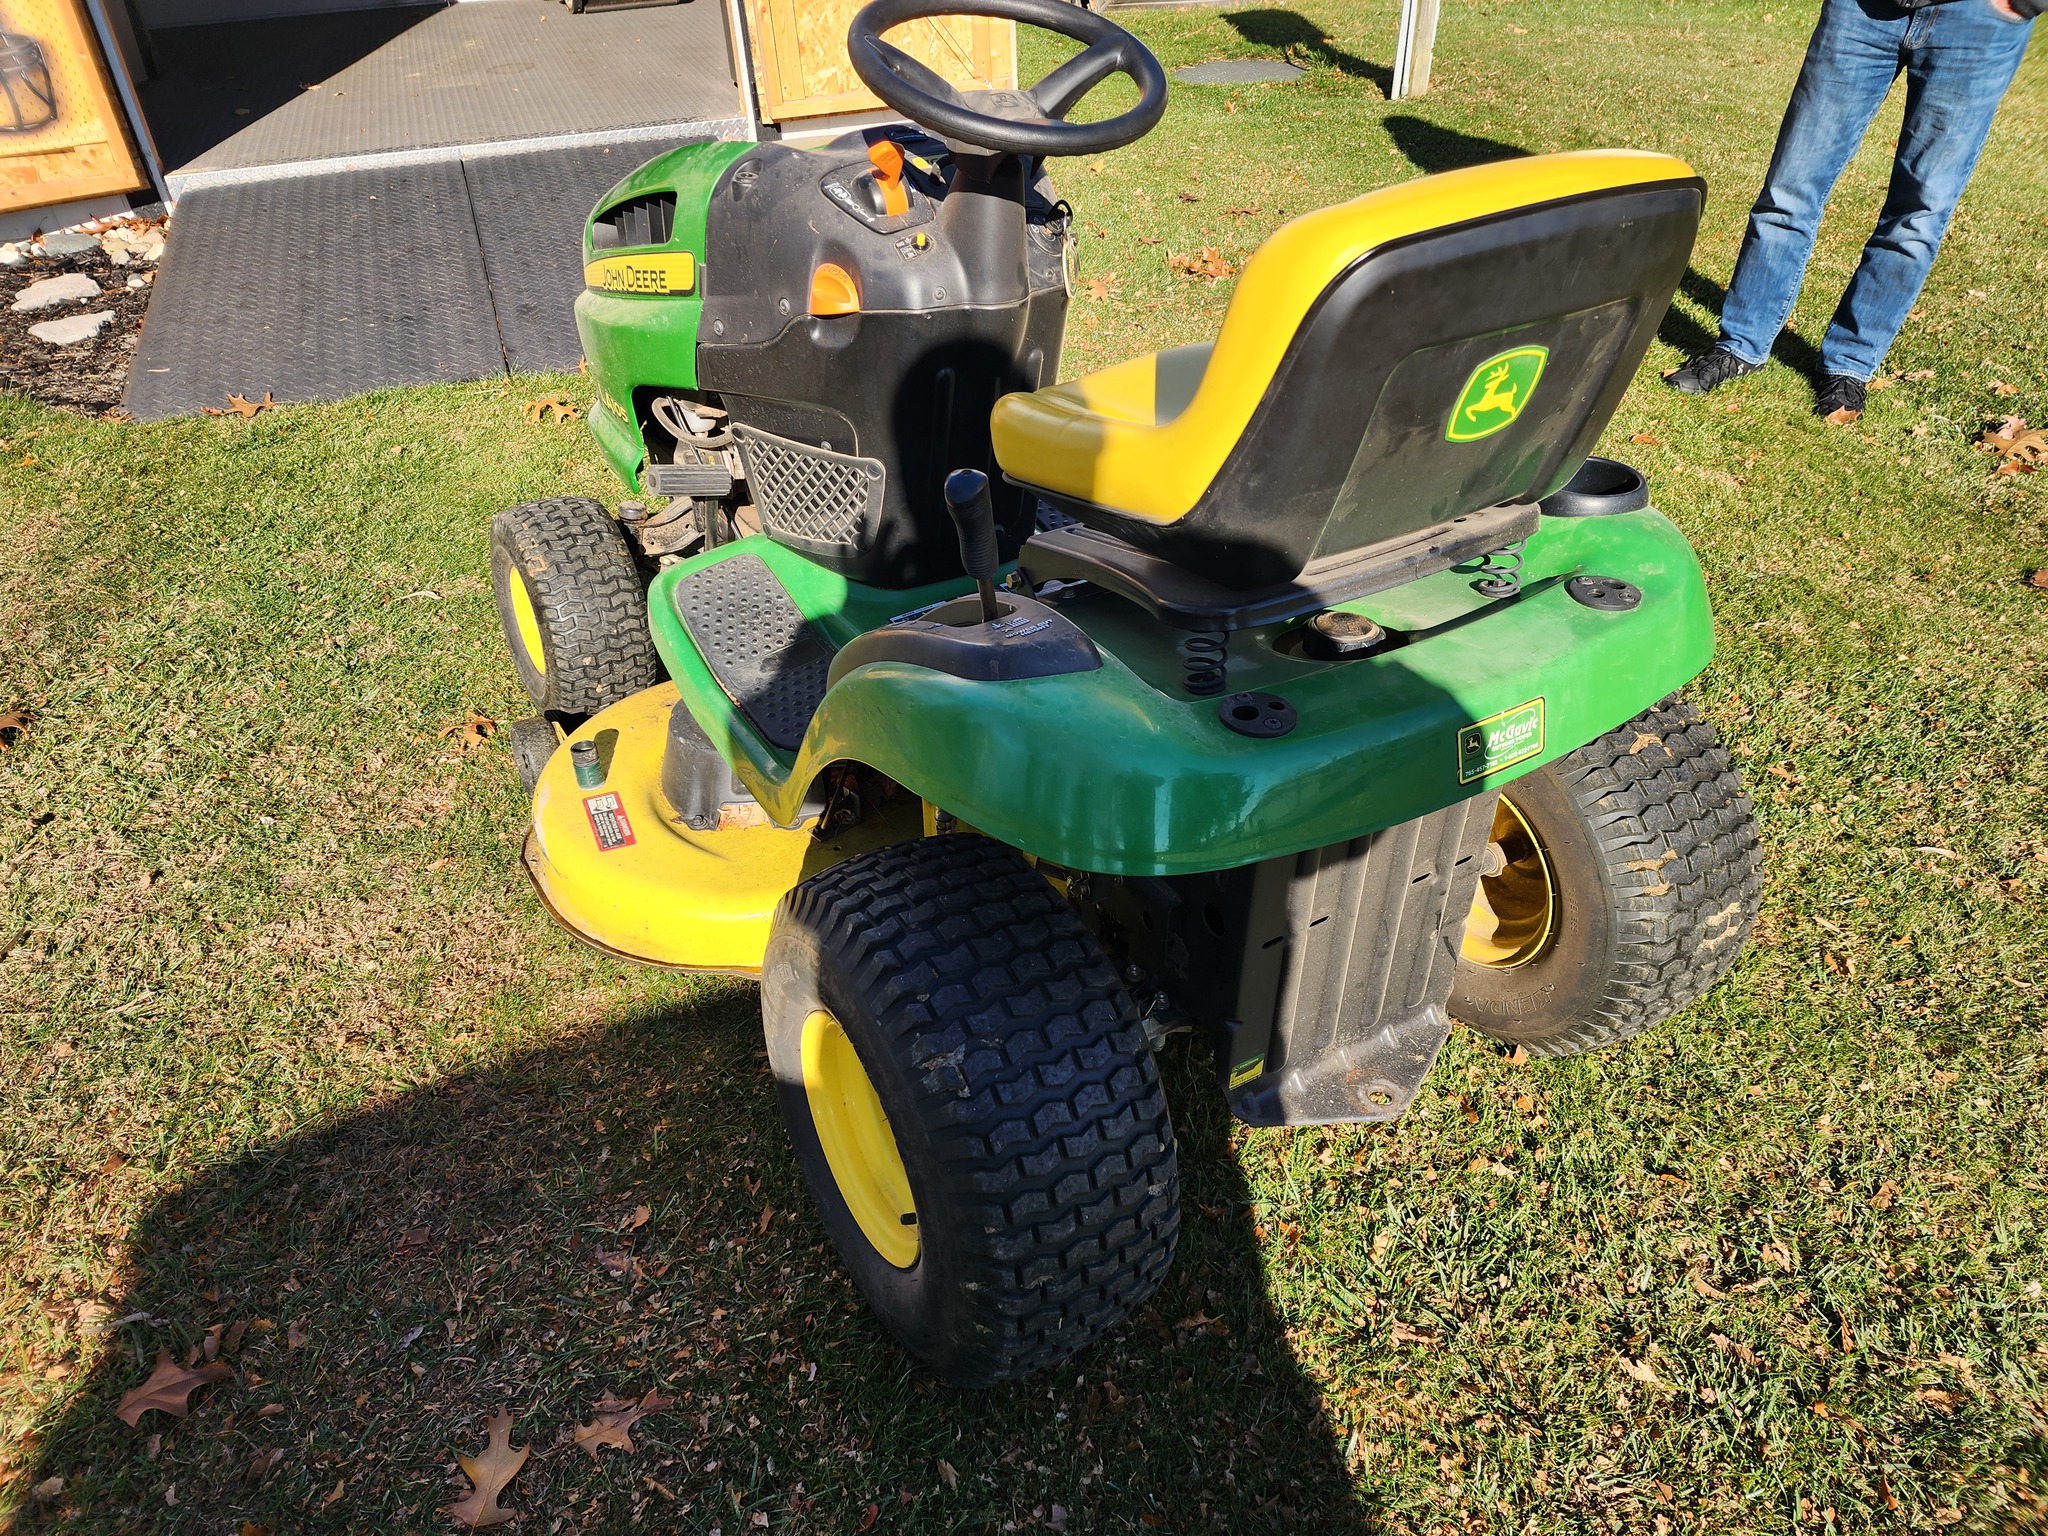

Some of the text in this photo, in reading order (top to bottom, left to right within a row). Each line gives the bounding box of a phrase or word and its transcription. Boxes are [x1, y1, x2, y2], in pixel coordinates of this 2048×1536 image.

[603, 265, 667, 289] JOHN DEERE
[1488, 716, 1539, 746] McGavic
[620, 818, 631, 837] DANGER
[1474, 990, 1552, 1016] KENDA
